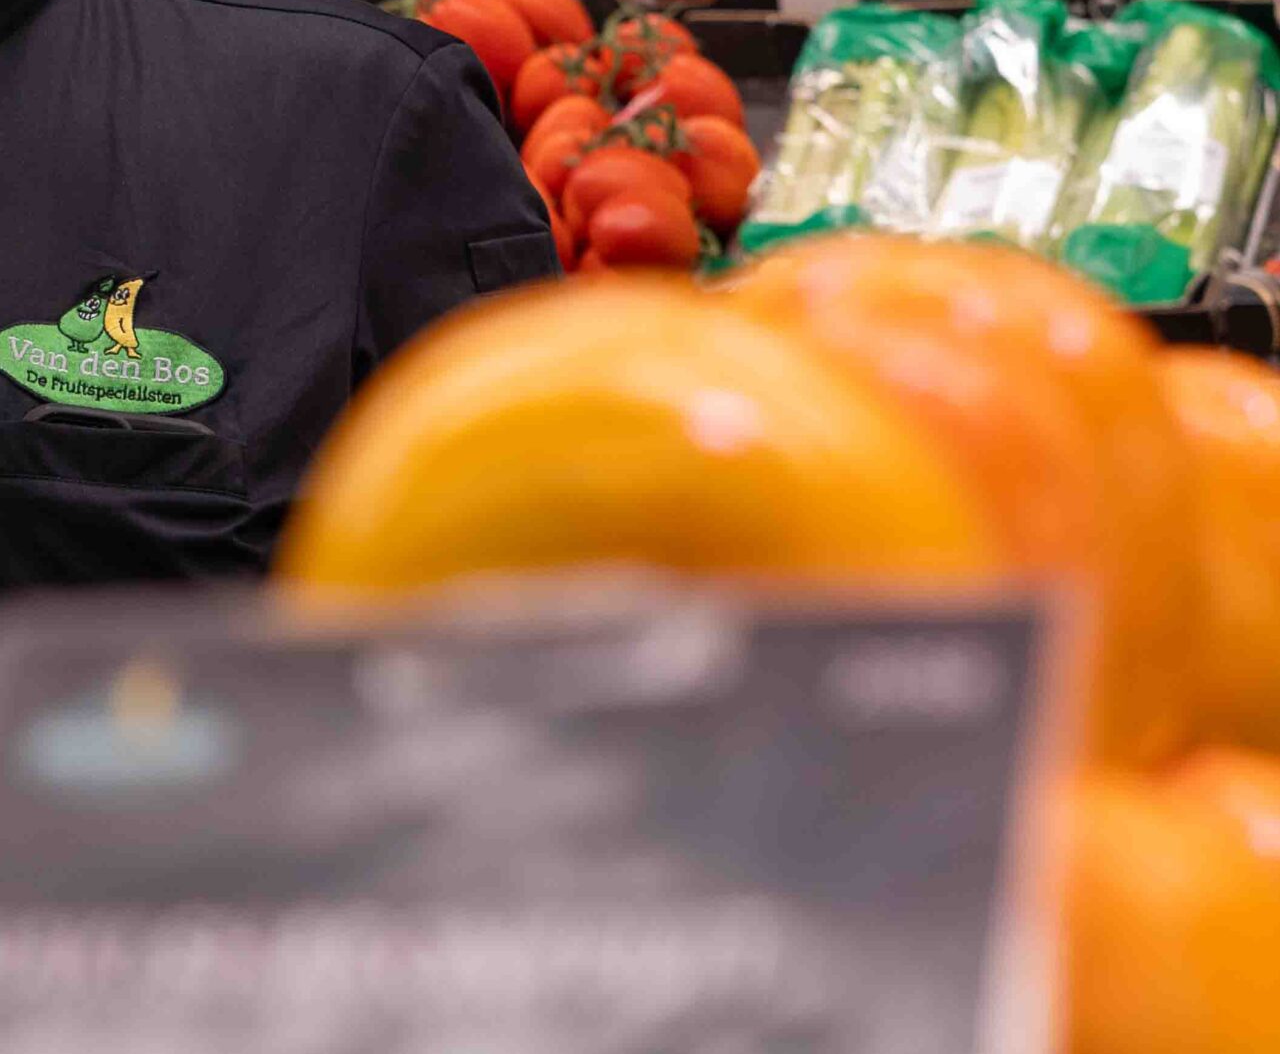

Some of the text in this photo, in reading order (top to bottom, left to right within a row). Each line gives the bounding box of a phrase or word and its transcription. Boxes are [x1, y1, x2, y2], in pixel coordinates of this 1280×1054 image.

[8, 336, 210, 386] Van den Bos
[26, 370, 182, 405] De Fruitspecialisten
